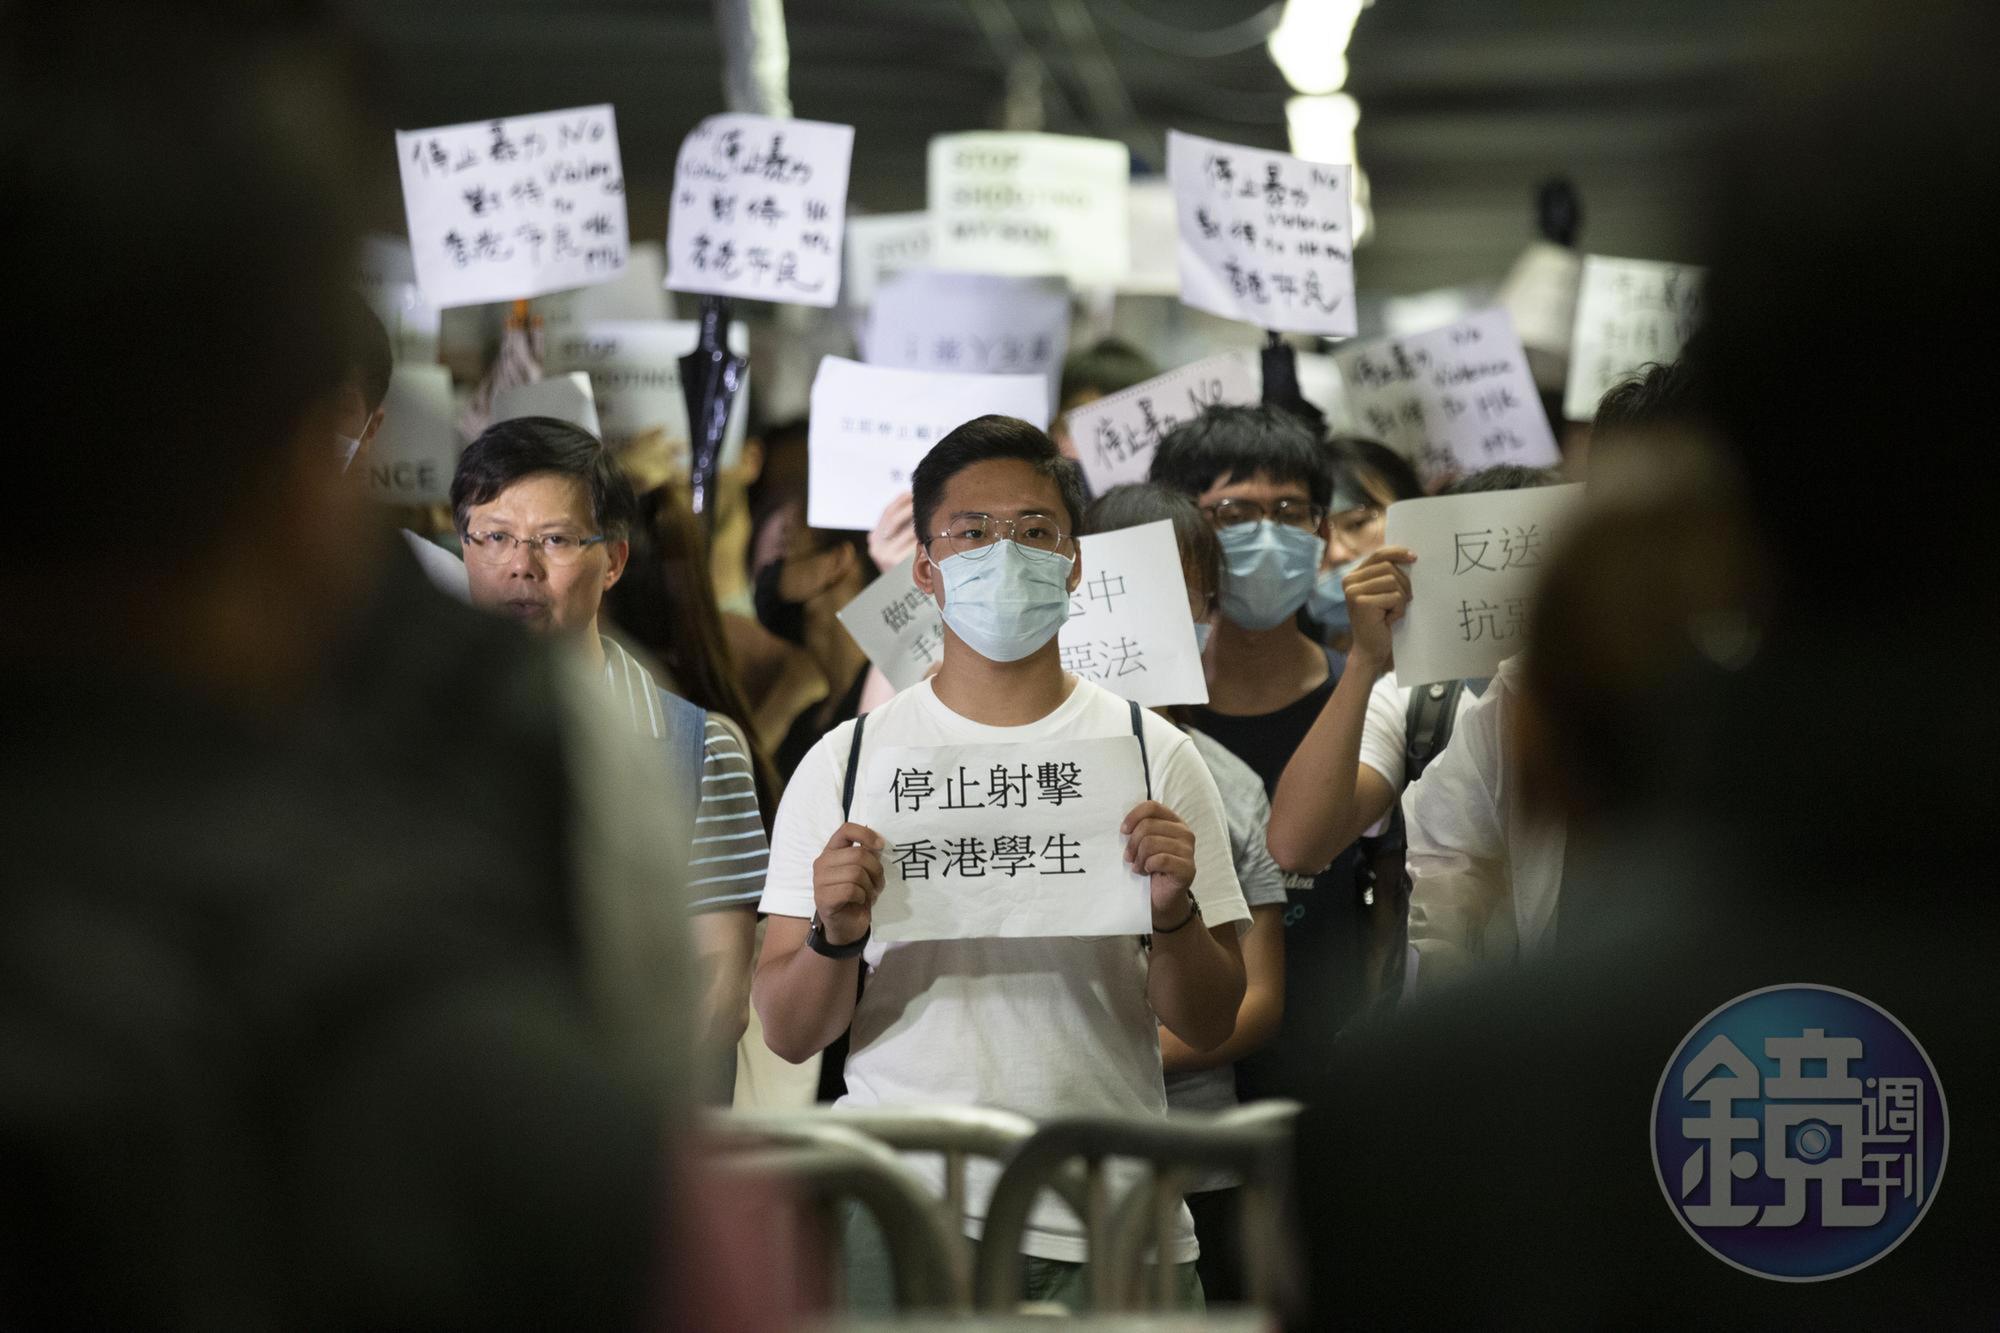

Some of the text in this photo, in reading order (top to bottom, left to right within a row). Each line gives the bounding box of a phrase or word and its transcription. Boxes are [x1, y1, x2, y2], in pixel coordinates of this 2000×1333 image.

[1453, 524, 1556, 576] 反送
[889, 762, 1083, 813] 停止射擊
[891, 833, 1087, 881] 香港學生
